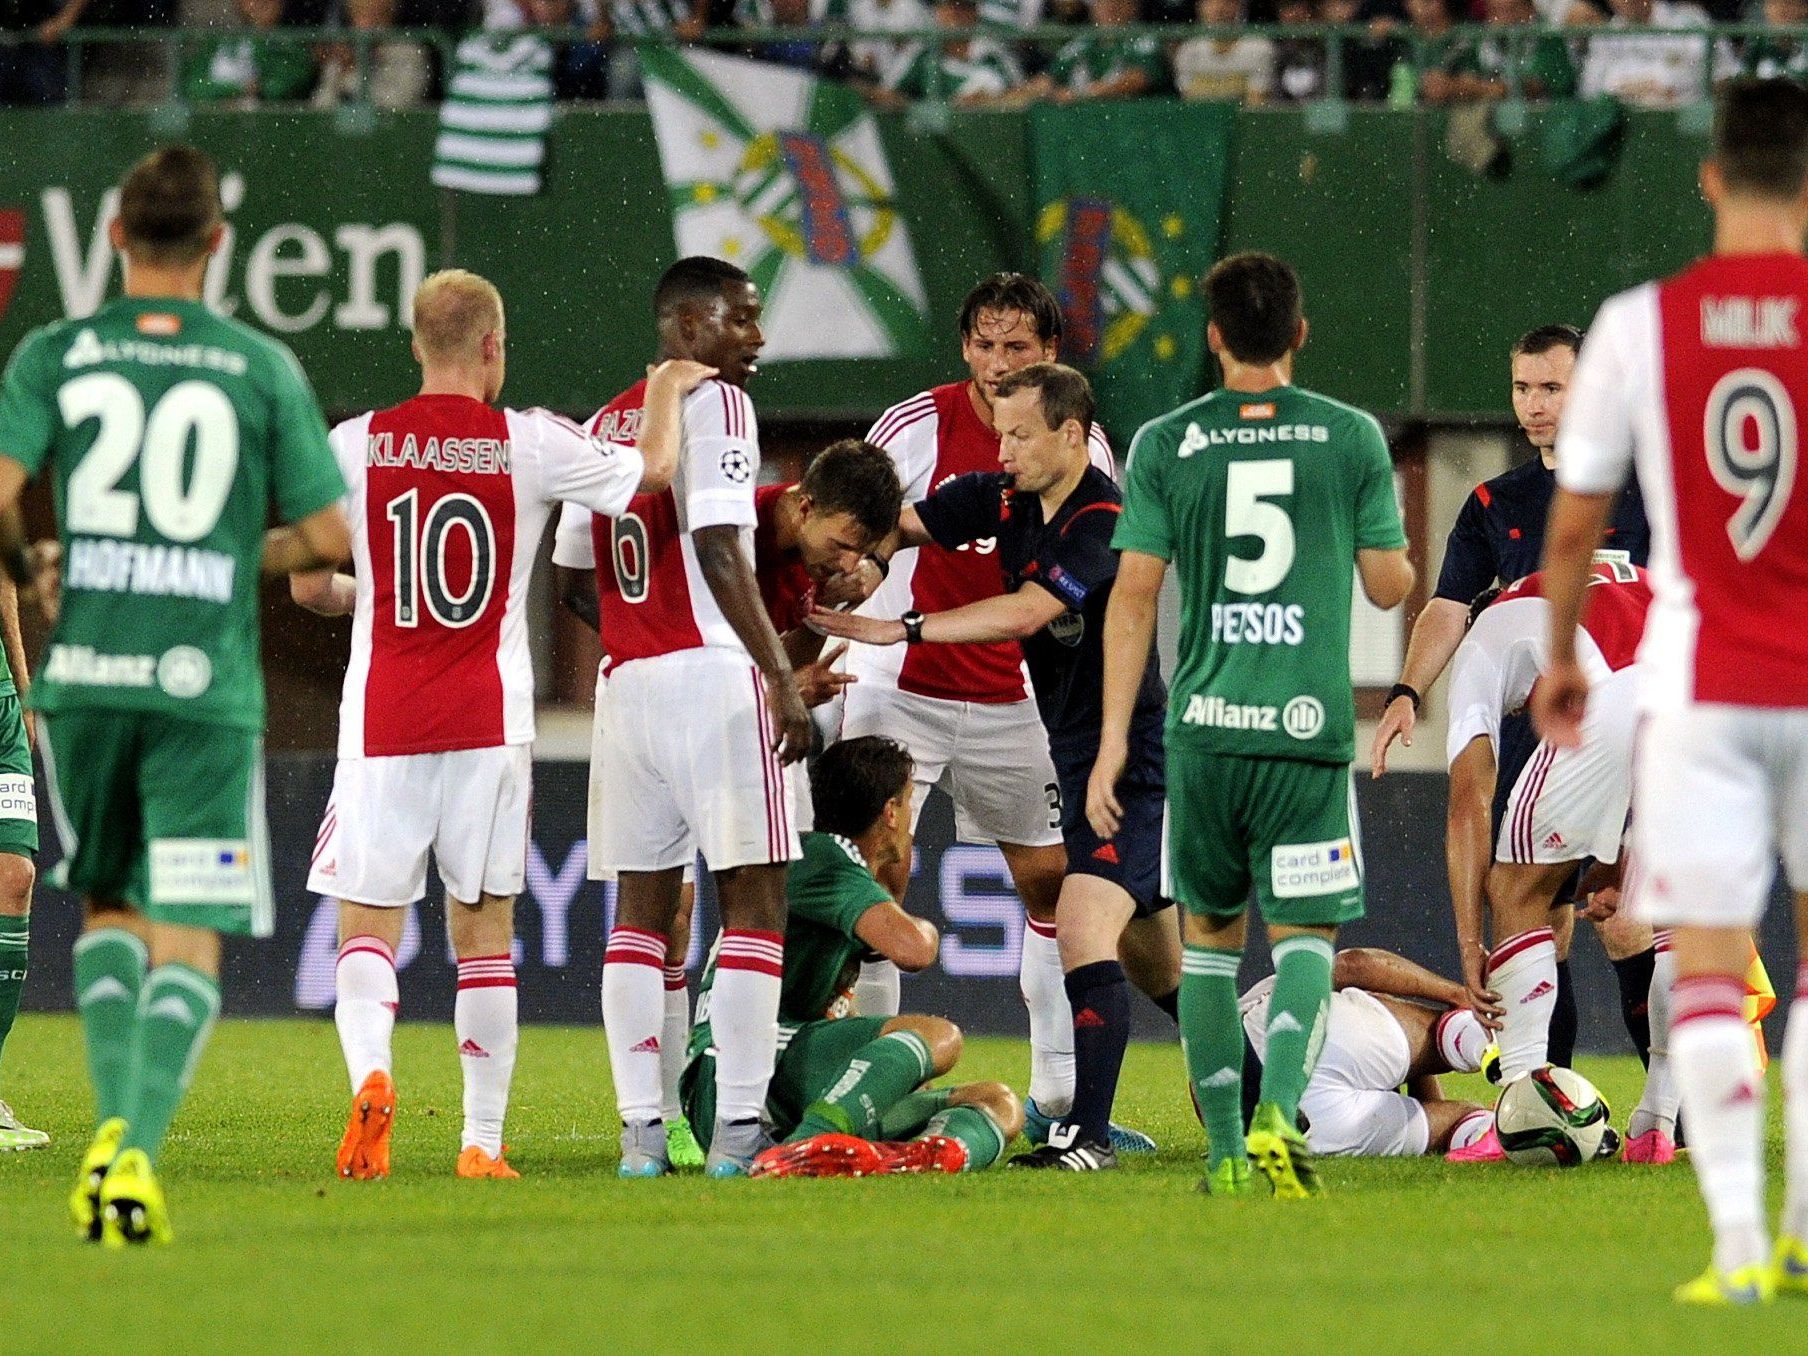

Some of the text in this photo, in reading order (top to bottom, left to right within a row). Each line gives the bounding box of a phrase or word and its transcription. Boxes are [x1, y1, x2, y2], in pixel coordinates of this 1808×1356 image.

[56, 371, 240, 543] 20
[367, 432, 511, 474] KLAASSEN
[1210, 424, 1329, 442] LYONESS
[1703, 367, 1797, 564] 9
[1224, 459, 1296, 596] 5
[68, 538, 236, 604] HOFMANN
[387, 487, 497, 629] 10
[611, 512, 649, 604] 6
[43, 644, 158, 687] Allianz
[1182, 693, 1279, 731] Allianz
[1044, 782, 1064, 829] 3
[1276, 850, 1320, 869] card
